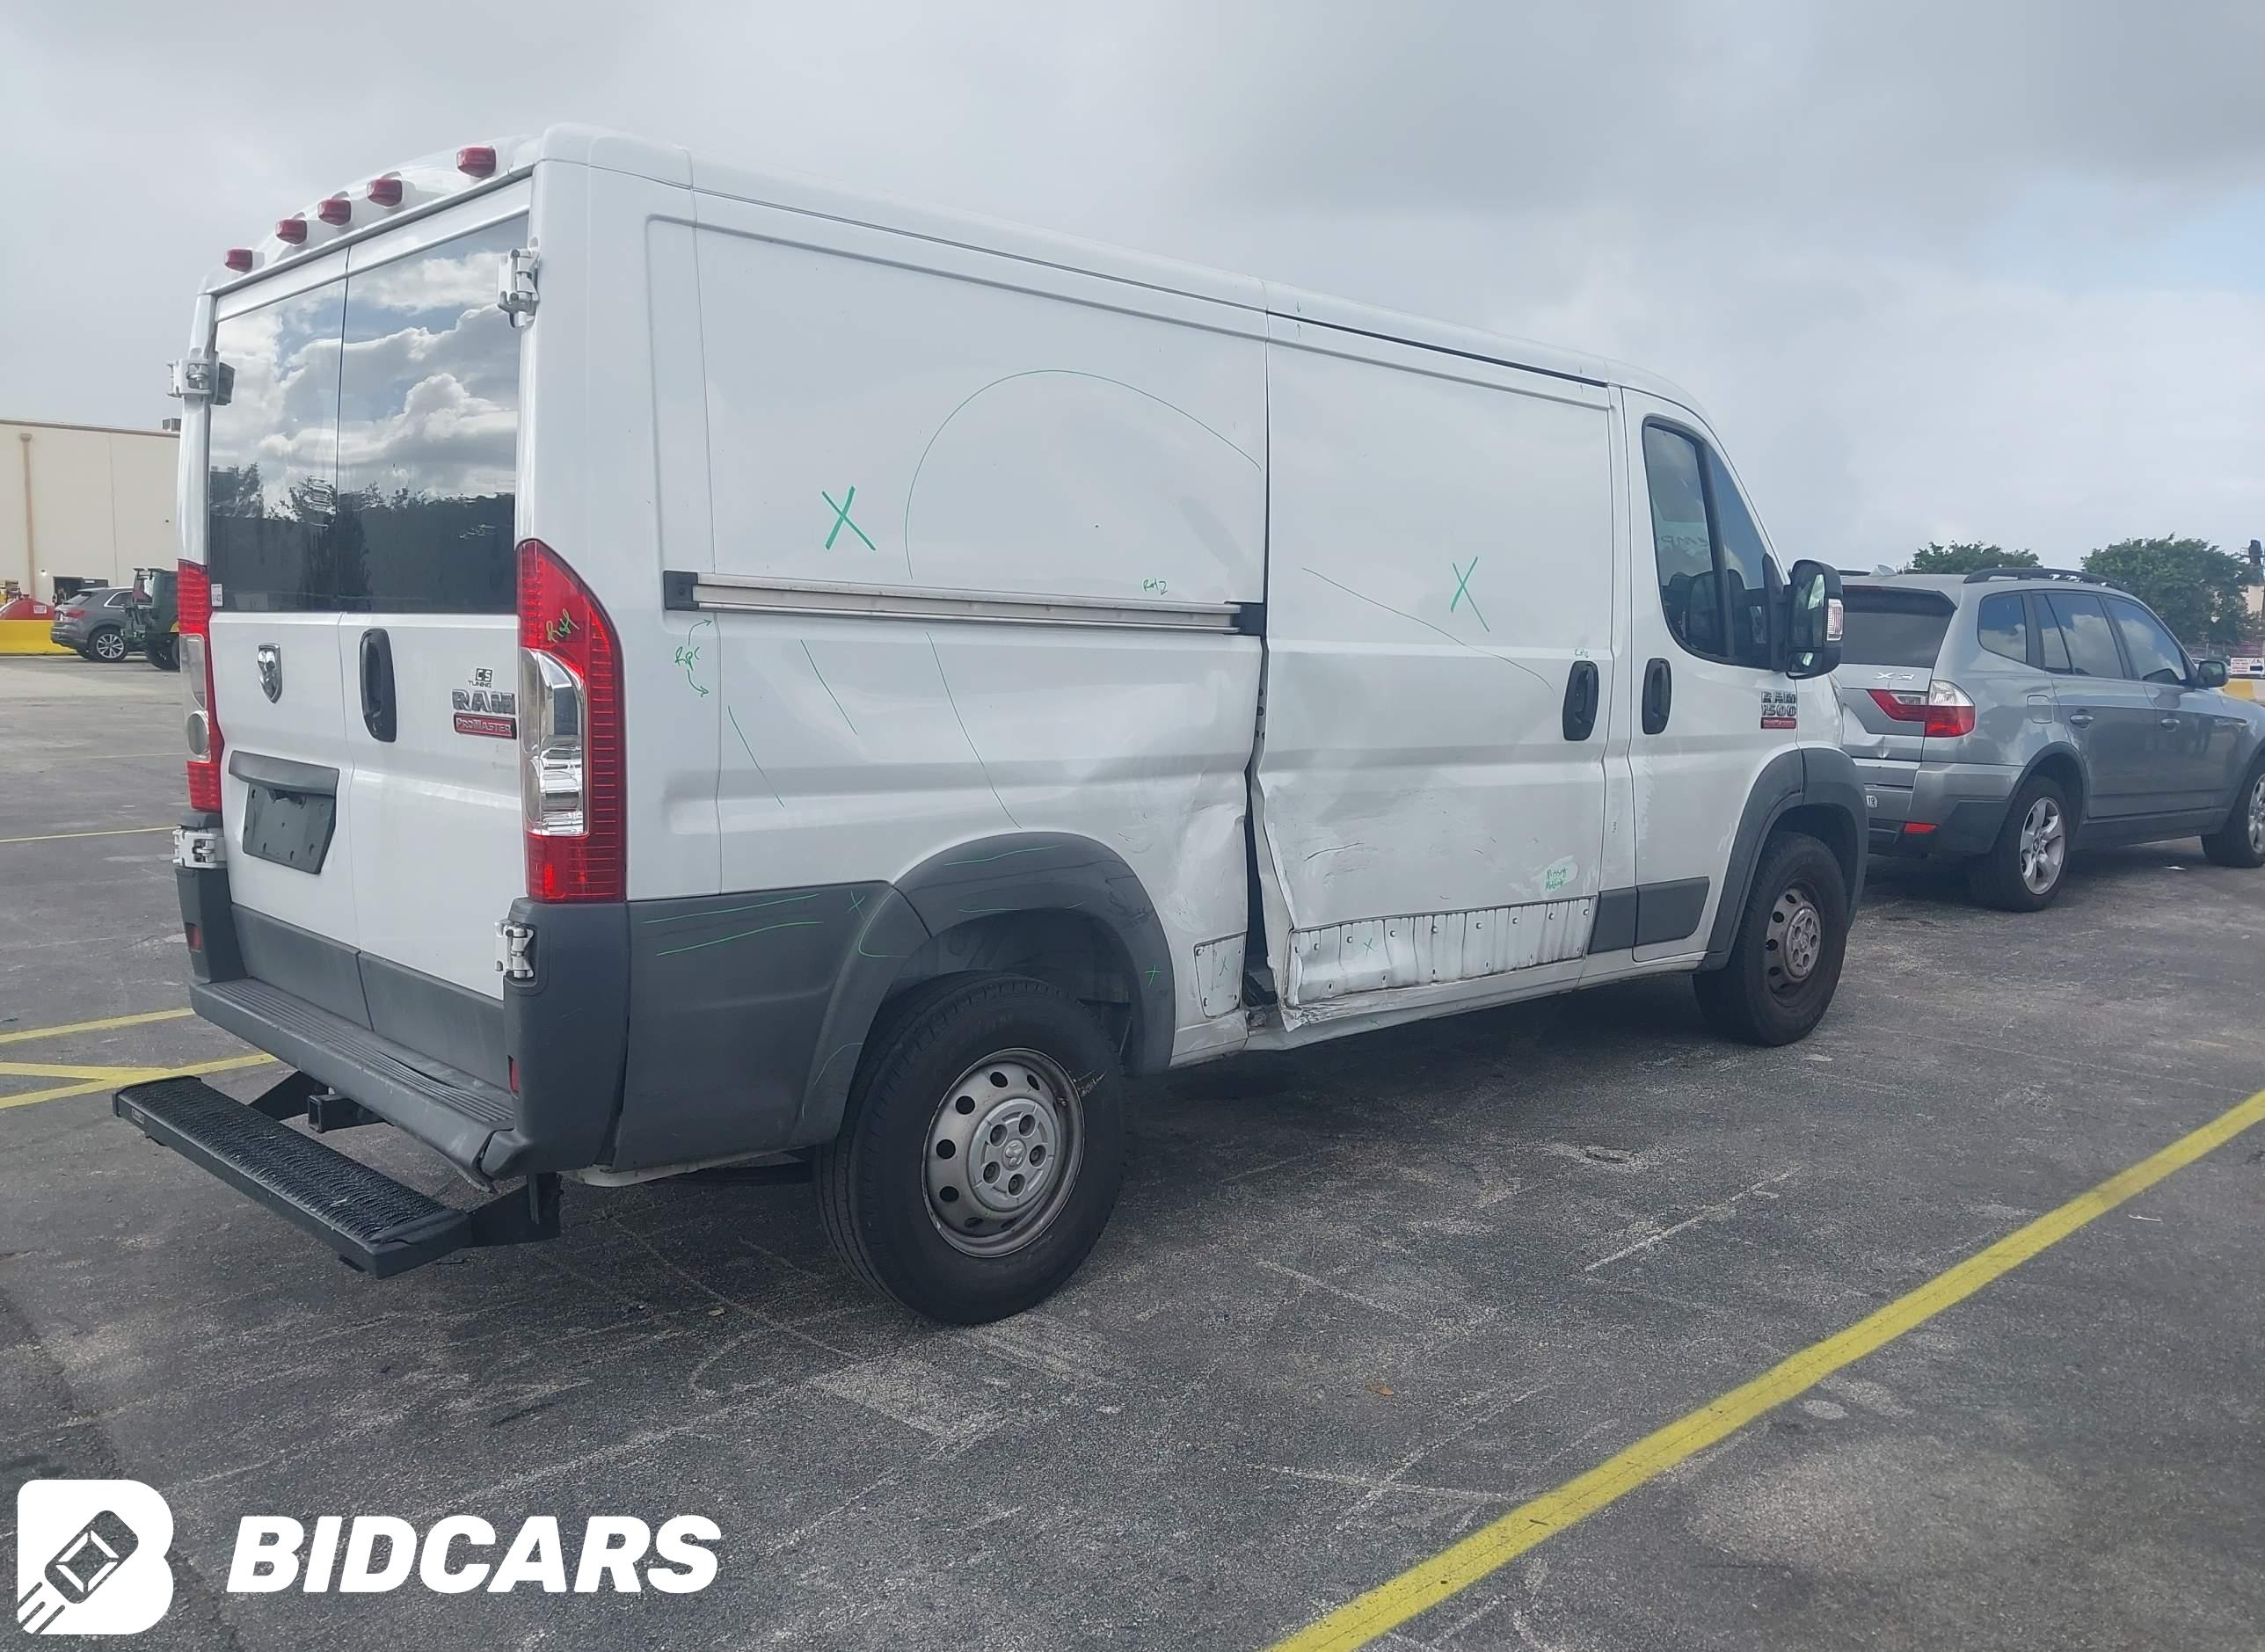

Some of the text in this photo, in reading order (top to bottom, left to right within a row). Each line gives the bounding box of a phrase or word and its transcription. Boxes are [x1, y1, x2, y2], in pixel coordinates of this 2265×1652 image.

[476, 668, 492, 682] CS
[1873, 671, 1915, 681] X3
[451, 688, 515, 715] RAM
[1760, 690, 1795, 704] RAM
[1760, 704, 1796, 717] 1500
